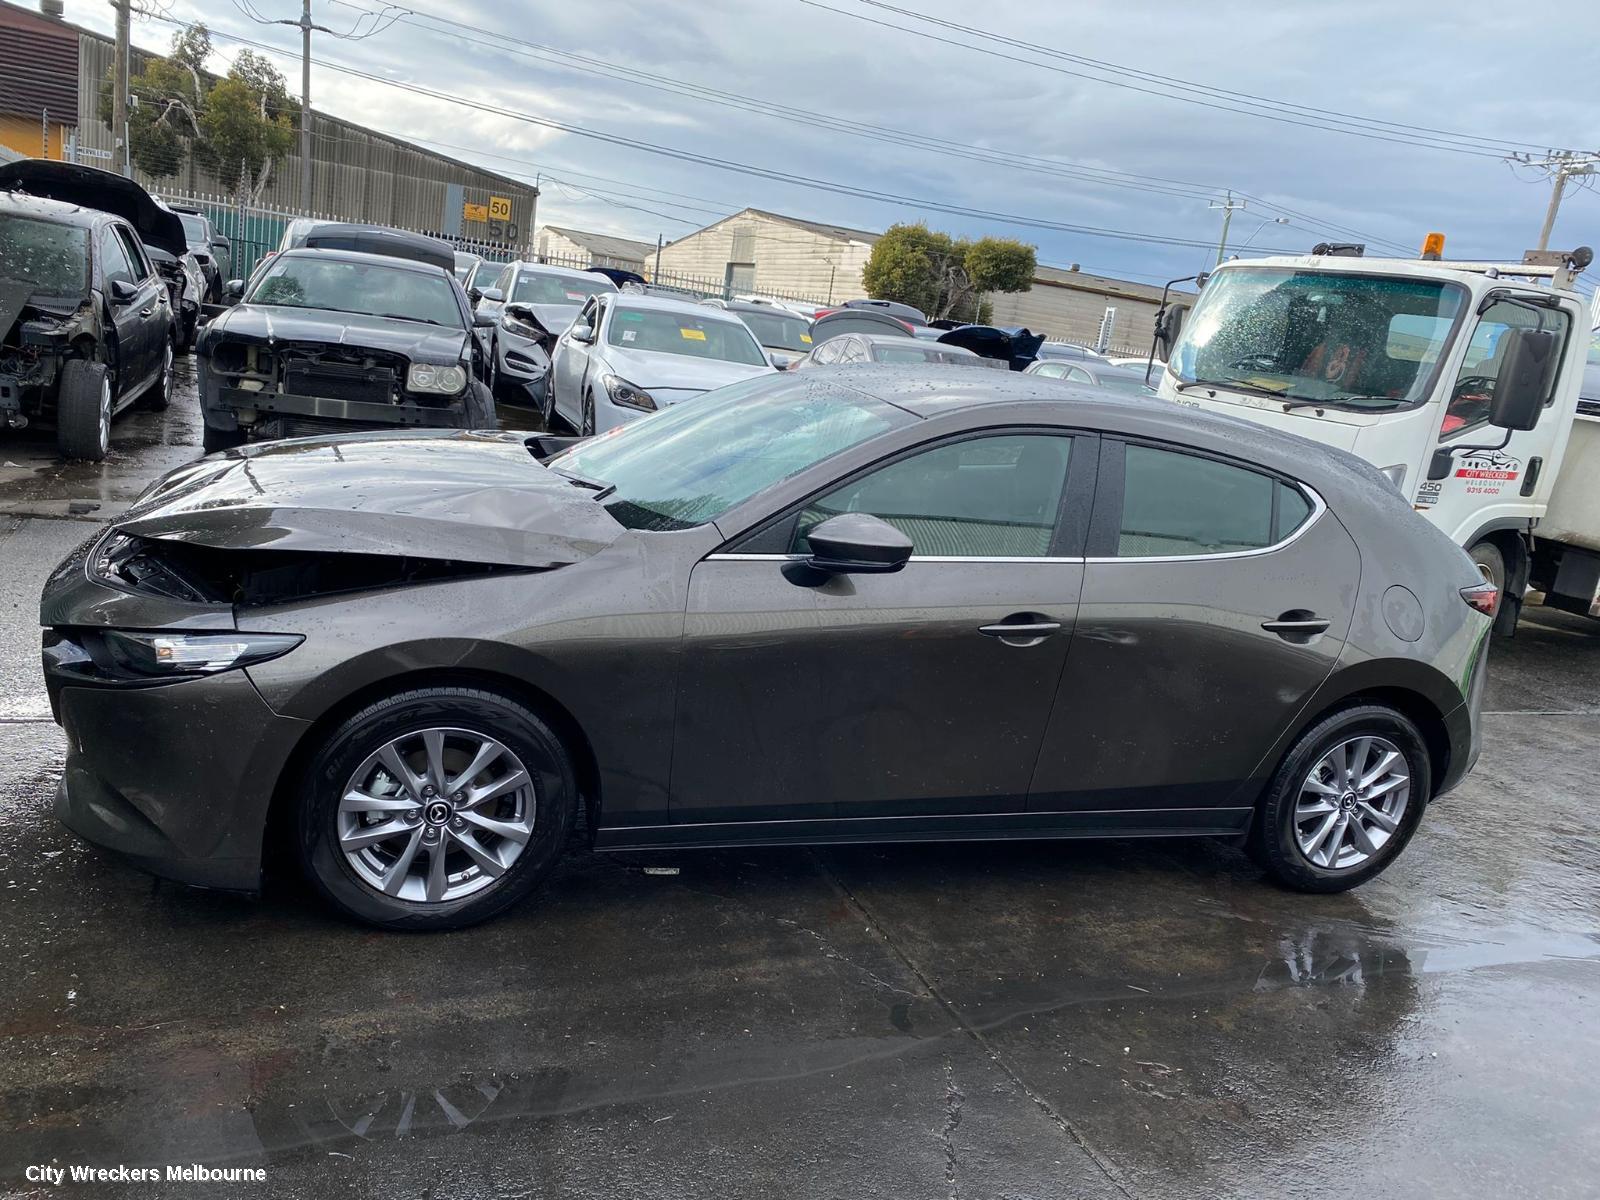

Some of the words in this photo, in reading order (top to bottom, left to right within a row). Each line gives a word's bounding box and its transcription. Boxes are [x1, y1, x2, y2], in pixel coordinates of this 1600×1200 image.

[491, 202, 508, 215] 50
[489, 220, 518, 240] 50
[1466, 470, 1479, 478] CITY
[1479, 471, 1508, 479] WRECKERS
[1420, 482, 1442, 492] 450
